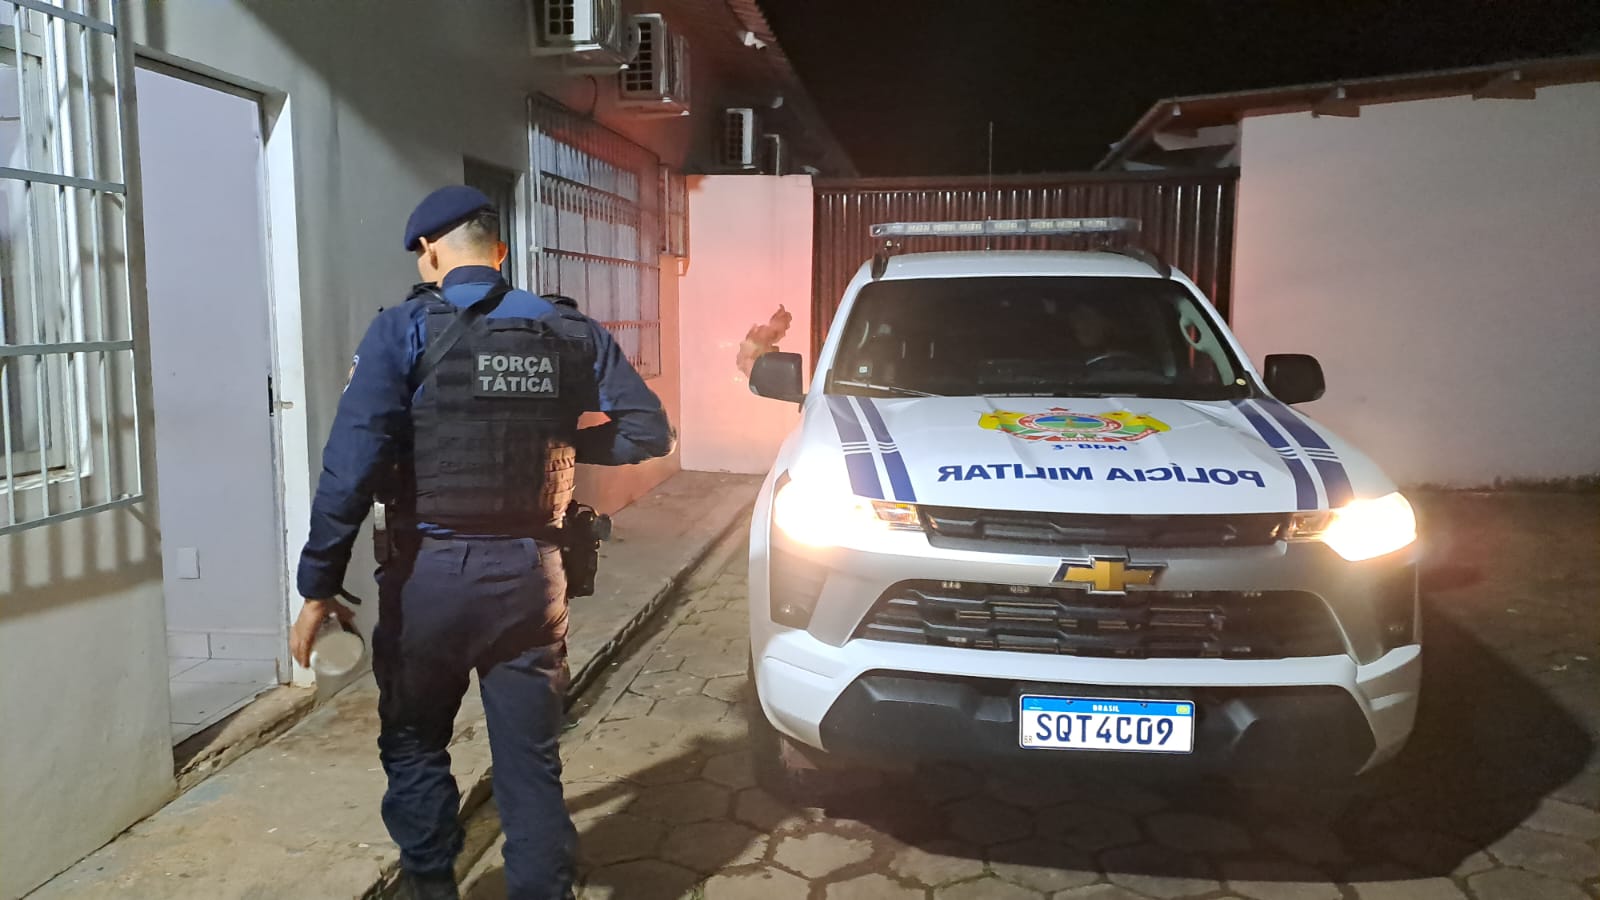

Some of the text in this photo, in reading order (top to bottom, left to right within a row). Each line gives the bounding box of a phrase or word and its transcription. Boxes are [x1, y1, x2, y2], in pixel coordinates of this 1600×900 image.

[478, 355, 554, 376] FORÇA
[478, 373, 554, 393] TÁTICA
[1078, 443, 1128, 452] BPM
[1092, 704, 1120, 713] BRASIL
[1035, 713, 1174, 746] SQT4C09
